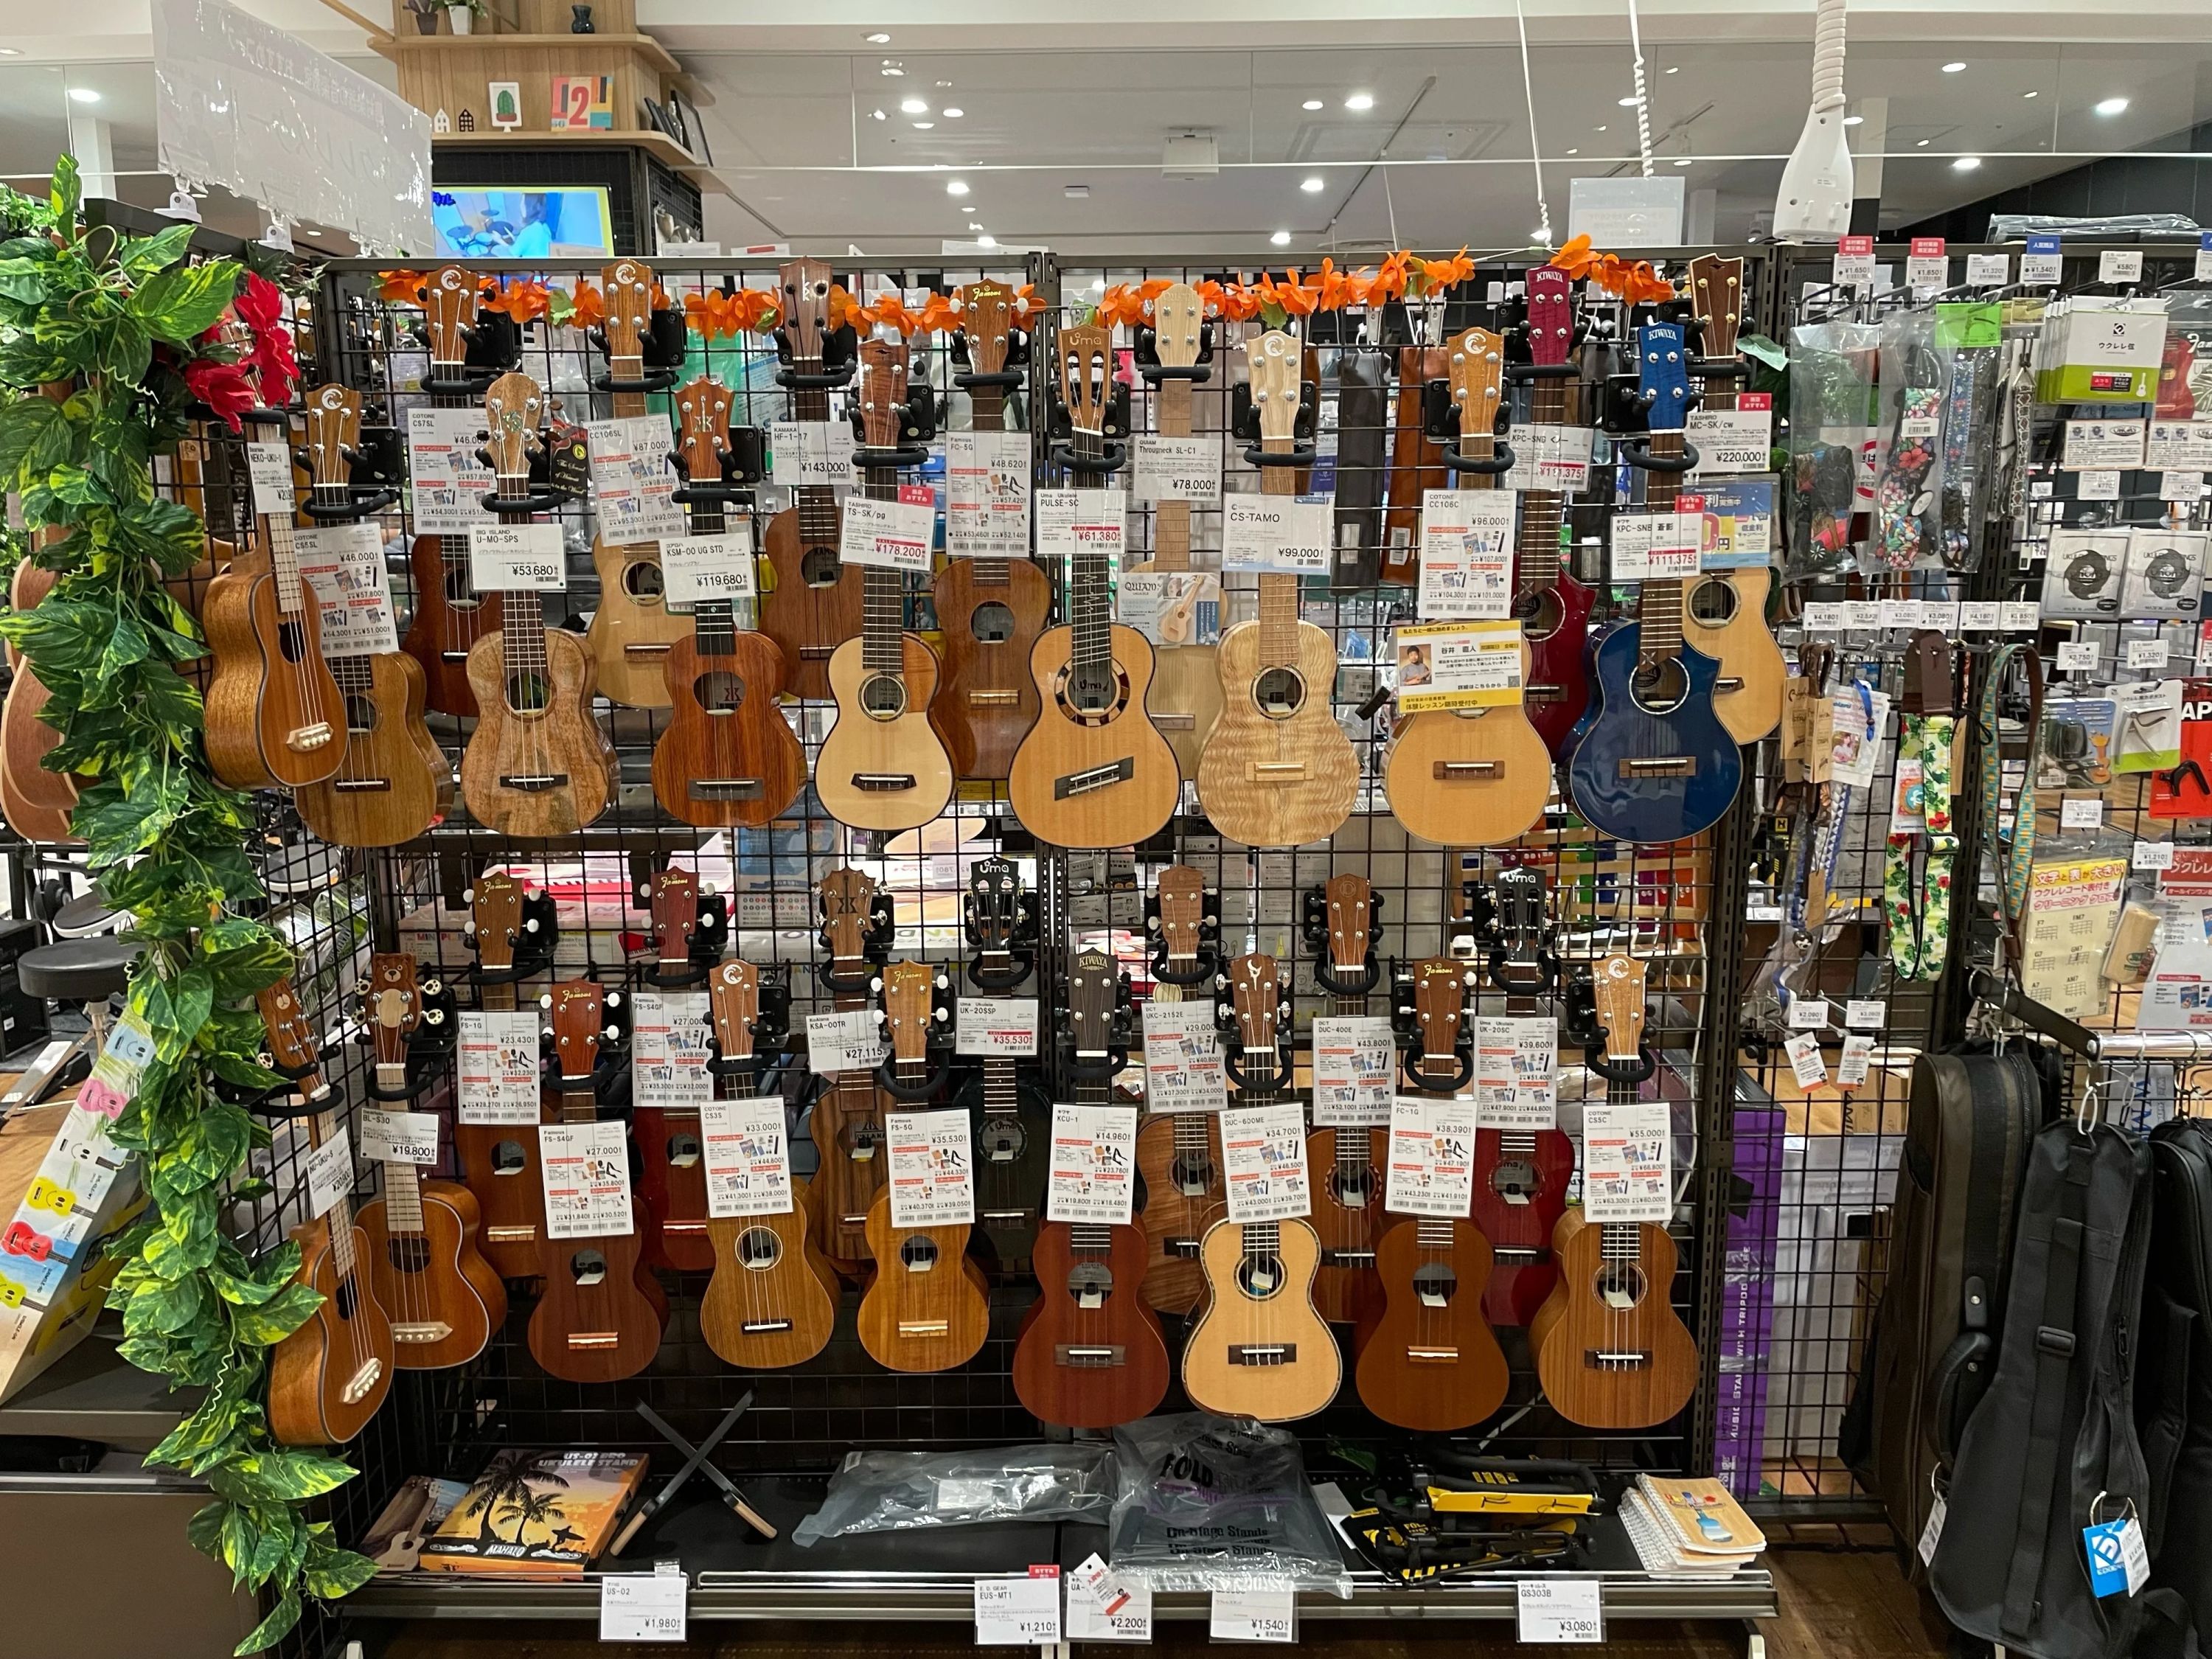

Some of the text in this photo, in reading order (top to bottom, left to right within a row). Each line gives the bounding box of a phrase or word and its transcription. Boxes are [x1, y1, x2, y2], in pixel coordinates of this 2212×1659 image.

[1536, 271, 1563, 283] KIWAYA
[973, 288, 1001, 300] Famous
[1648, 330, 1677, 341] KIWAYA
[1690, 421, 1733, 429] MC-SK/cw
[590, 430, 622, 439] CC106SL
[774, 432, 808, 441] HF-1-17
[634, 442, 666, 452] ¥87,000
[1139, 445, 1172, 454] Througneck
[1716, 452, 1761, 462] ¥220,000
[801, 462, 845, 473] ¥143,000
[991, 460, 1023, 468] ¥48,620
[1173, 479, 1211, 490] ¥78,000
[1040, 498, 1079, 507] PULSE-SC
[1231, 512, 1280, 523] CS-TAMO
[1472, 517, 1506, 526] ¥96,000
[1079, 532, 1117, 541] ¥61,380
[667, 547, 695, 557] KSM-00
[709, 545, 723, 553] STD
[876, 543, 921, 557] ¥178,200
[1279, 548, 1319, 557] ¥99,000
[340, 552, 375, 562] ¥46,000
[1649, 554, 1693, 565] ¥111,375
[512, 566, 553, 576] ¥53,680
[697, 574, 742, 586] ¥119,680
[979, 861, 1009, 873] Uma
[484, 881, 512, 892] Famous
[661, 876, 688, 888] Famous
[1079, 957, 1108, 967] KIWAYA
[894, 970, 922, 982] Famous
[1425, 965, 1453, 977] Famous
[673, 1018, 704, 1026] ¥27,000
[810, 1021, 846, 1029] KSA-00TR
[1185, 1023, 1216, 1032] ¥29,000
[500, 1036, 532, 1044] ¥23,430
[994, 1036, 1029, 1045] ¥35,530
[846, 1048, 883, 1059] ¥27,115
[363, 1115, 390, 1124] BL-S30
[745, 1123, 778, 1132] ¥33,000
[1266, 1127, 1298, 1138] ¥34,700
[1436, 1125, 1469, 1133] ¥38,390
[932, 1135, 964, 1144] ¥35,530
[1096, 1133, 1127, 1141] ¥14,960
[392, 1146, 431, 1156] ¥19,800
[586, 1147, 619, 1155] ¥27,000
[1228, 1525, 1268, 1537] Stands
[484, 1545, 528, 1557] MAHALO
[607, 1587, 630, 1596] US-02
[979, 1592, 1012, 1600] EUS-MT1
[1521, 1590, 1551, 1598] GS303B
[644, 1618, 676, 1628] ¥1,980
[1020, 1621, 1052, 1632] ¥1,210
[1110, 1618, 1144, 1628] ¥2,200
[1251, 1619, 1284, 1630] ¥1,540
[1560, 1621, 1593, 1631] ¥3,080
